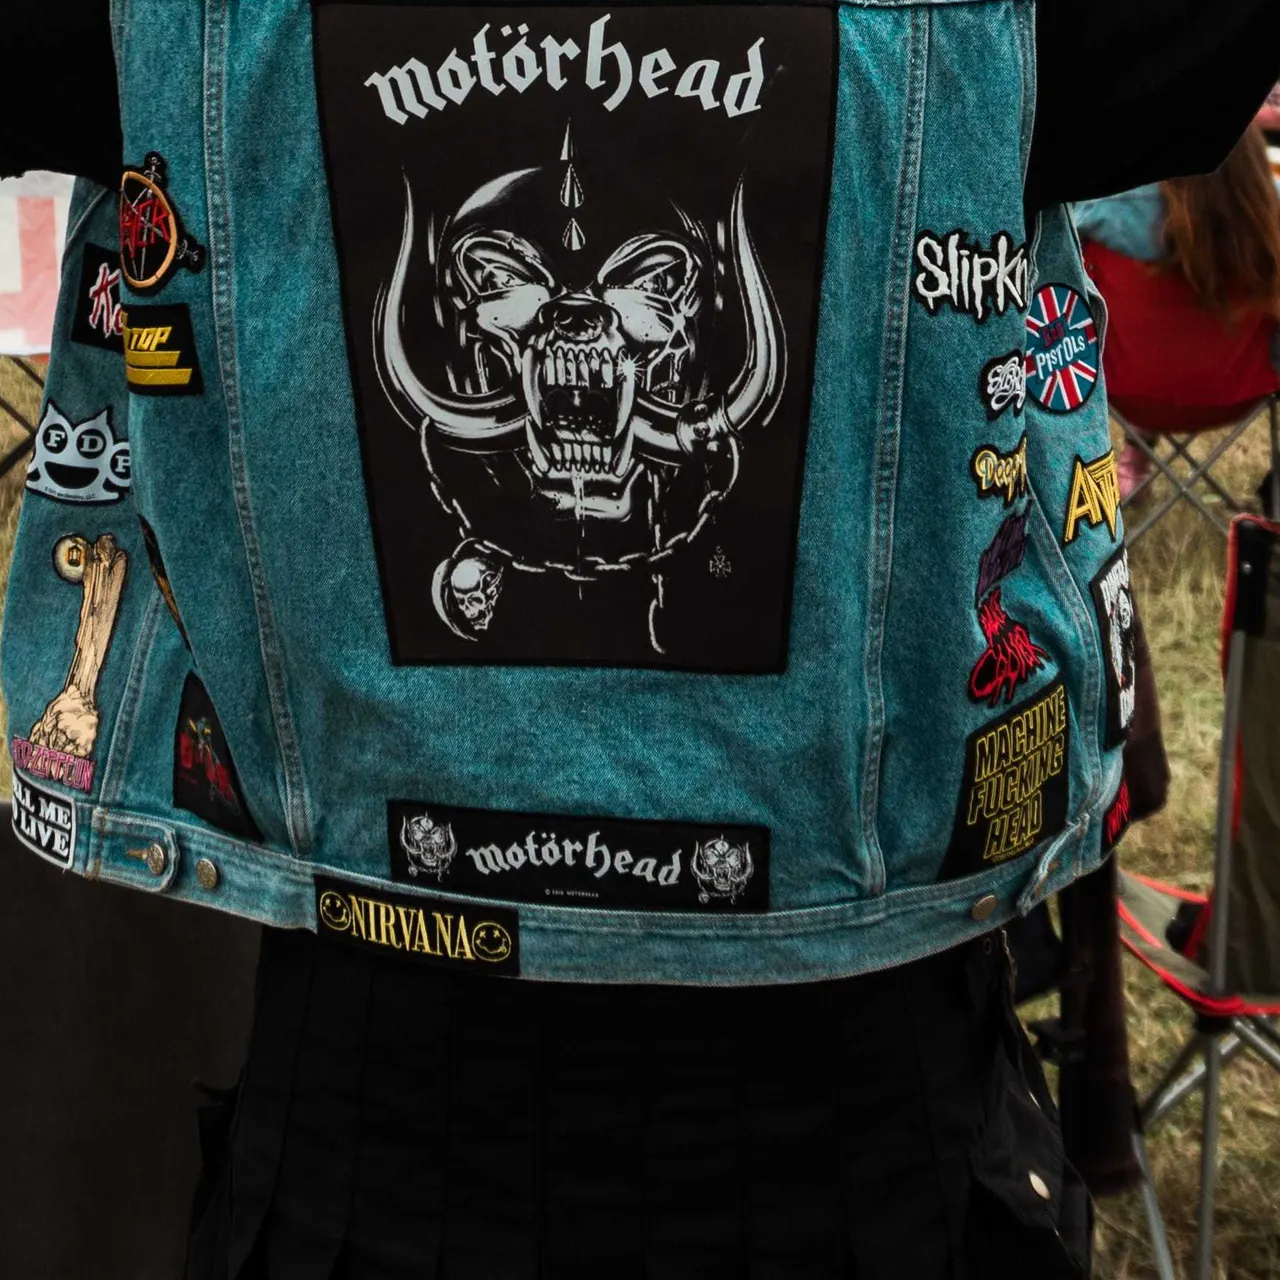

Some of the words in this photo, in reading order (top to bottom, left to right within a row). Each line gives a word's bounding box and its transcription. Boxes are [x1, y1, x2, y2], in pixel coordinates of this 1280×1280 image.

[363, 13, 766, 126] motörhead
[974, 685, 1067, 783] MACHINE
[967, 733, 1065, 825] FUCKING
[20, 807, 70, 857] LIVE
[38, 797, 72, 831] ME
[983, 790, 1043, 860] HEAD
[465, 830, 683, 886] motörhead
[350, 894, 477, 960] NIRVANA
